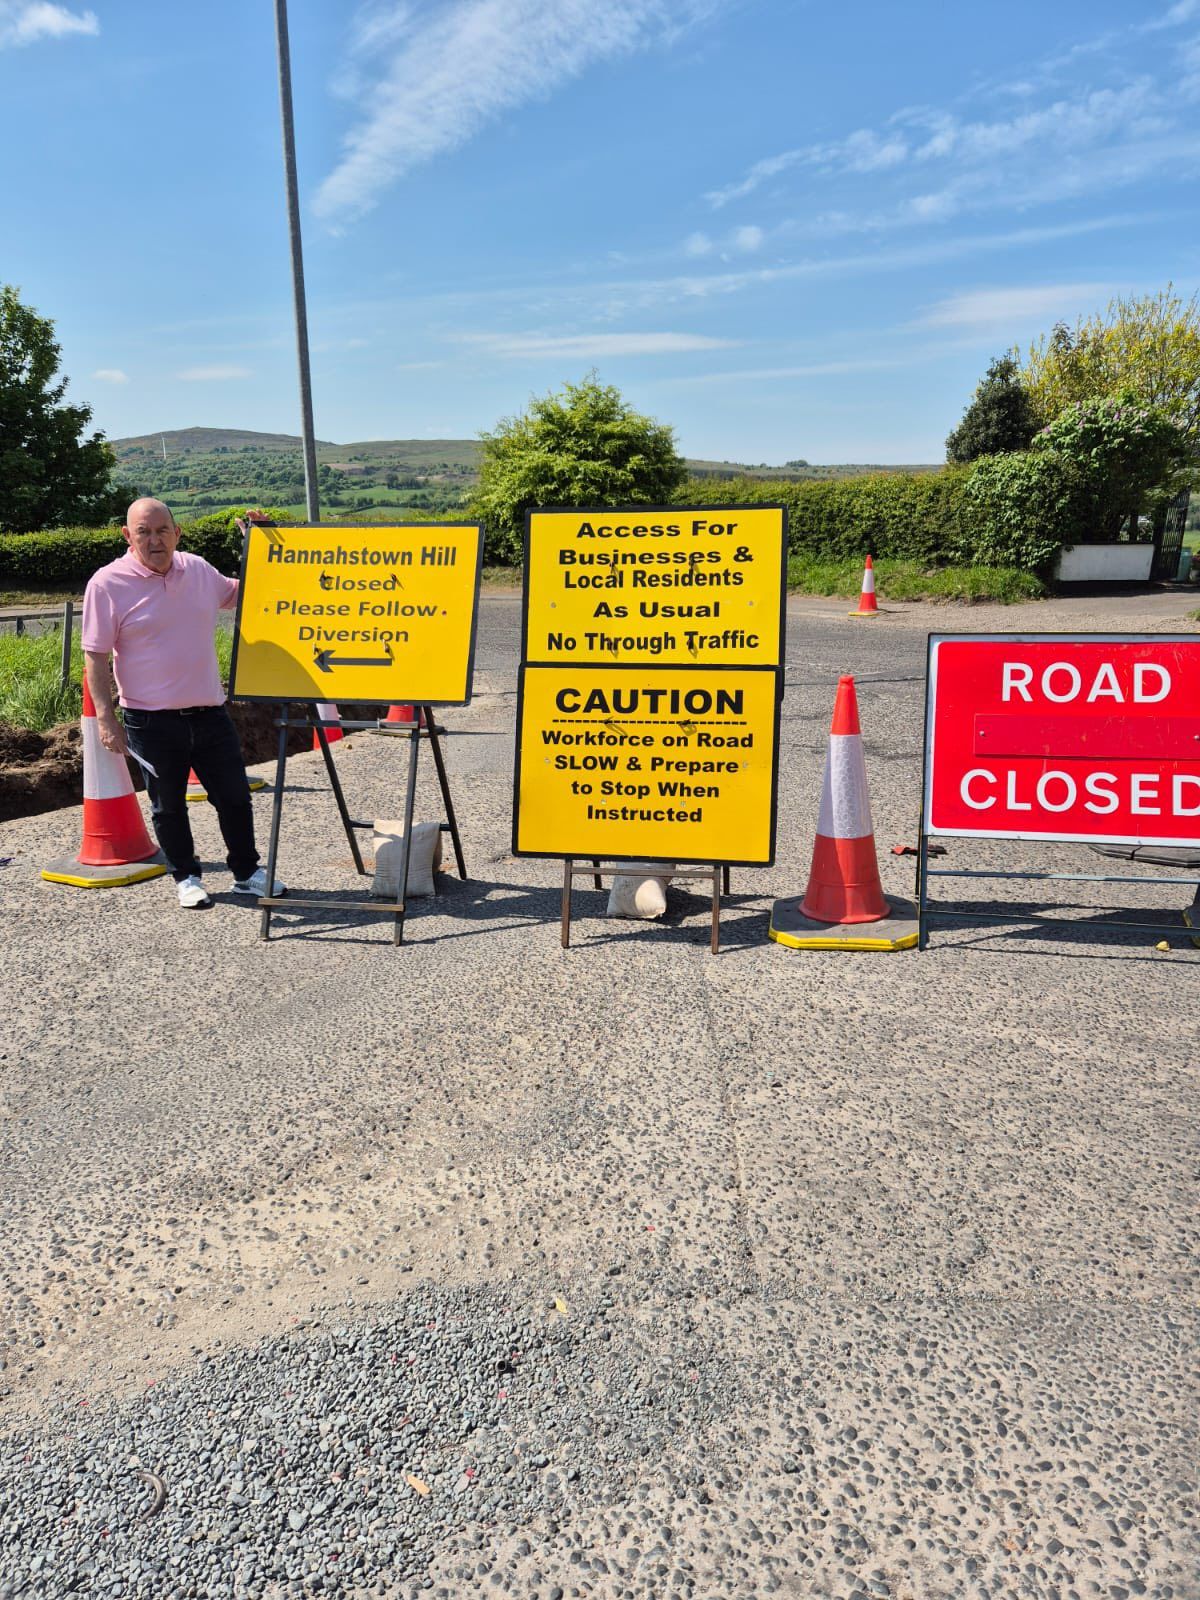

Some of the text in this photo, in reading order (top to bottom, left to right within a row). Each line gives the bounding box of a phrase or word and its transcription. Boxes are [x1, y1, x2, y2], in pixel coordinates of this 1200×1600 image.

[577, 521, 738, 538] Access For
[268, 544, 456, 566] Hannahstown Hill
[559, 547, 753, 565] Businesses &
[320, 575, 396, 591] Closed
[564, 569, 743, 589] Local Residents
[276, 600, 437, 617] Please Follow
[593, 602, 720, 618] As Usual
[298, 626, 409, 642] Diversion
[547, 630, 759, 654] No Through Traffic
[1002, 662, 1171, 703] ROAD
[555, 689, 744, 714] CAUTION
[542, 731, 753, 748] Workforce on Road
[554, 756, 739, 776] SLOW & Prepare
[572, 781, 719, 799] to Stop When
[960, 768, 1200, 817] CLOSED
[587, 806, 702, 822] Instructed
